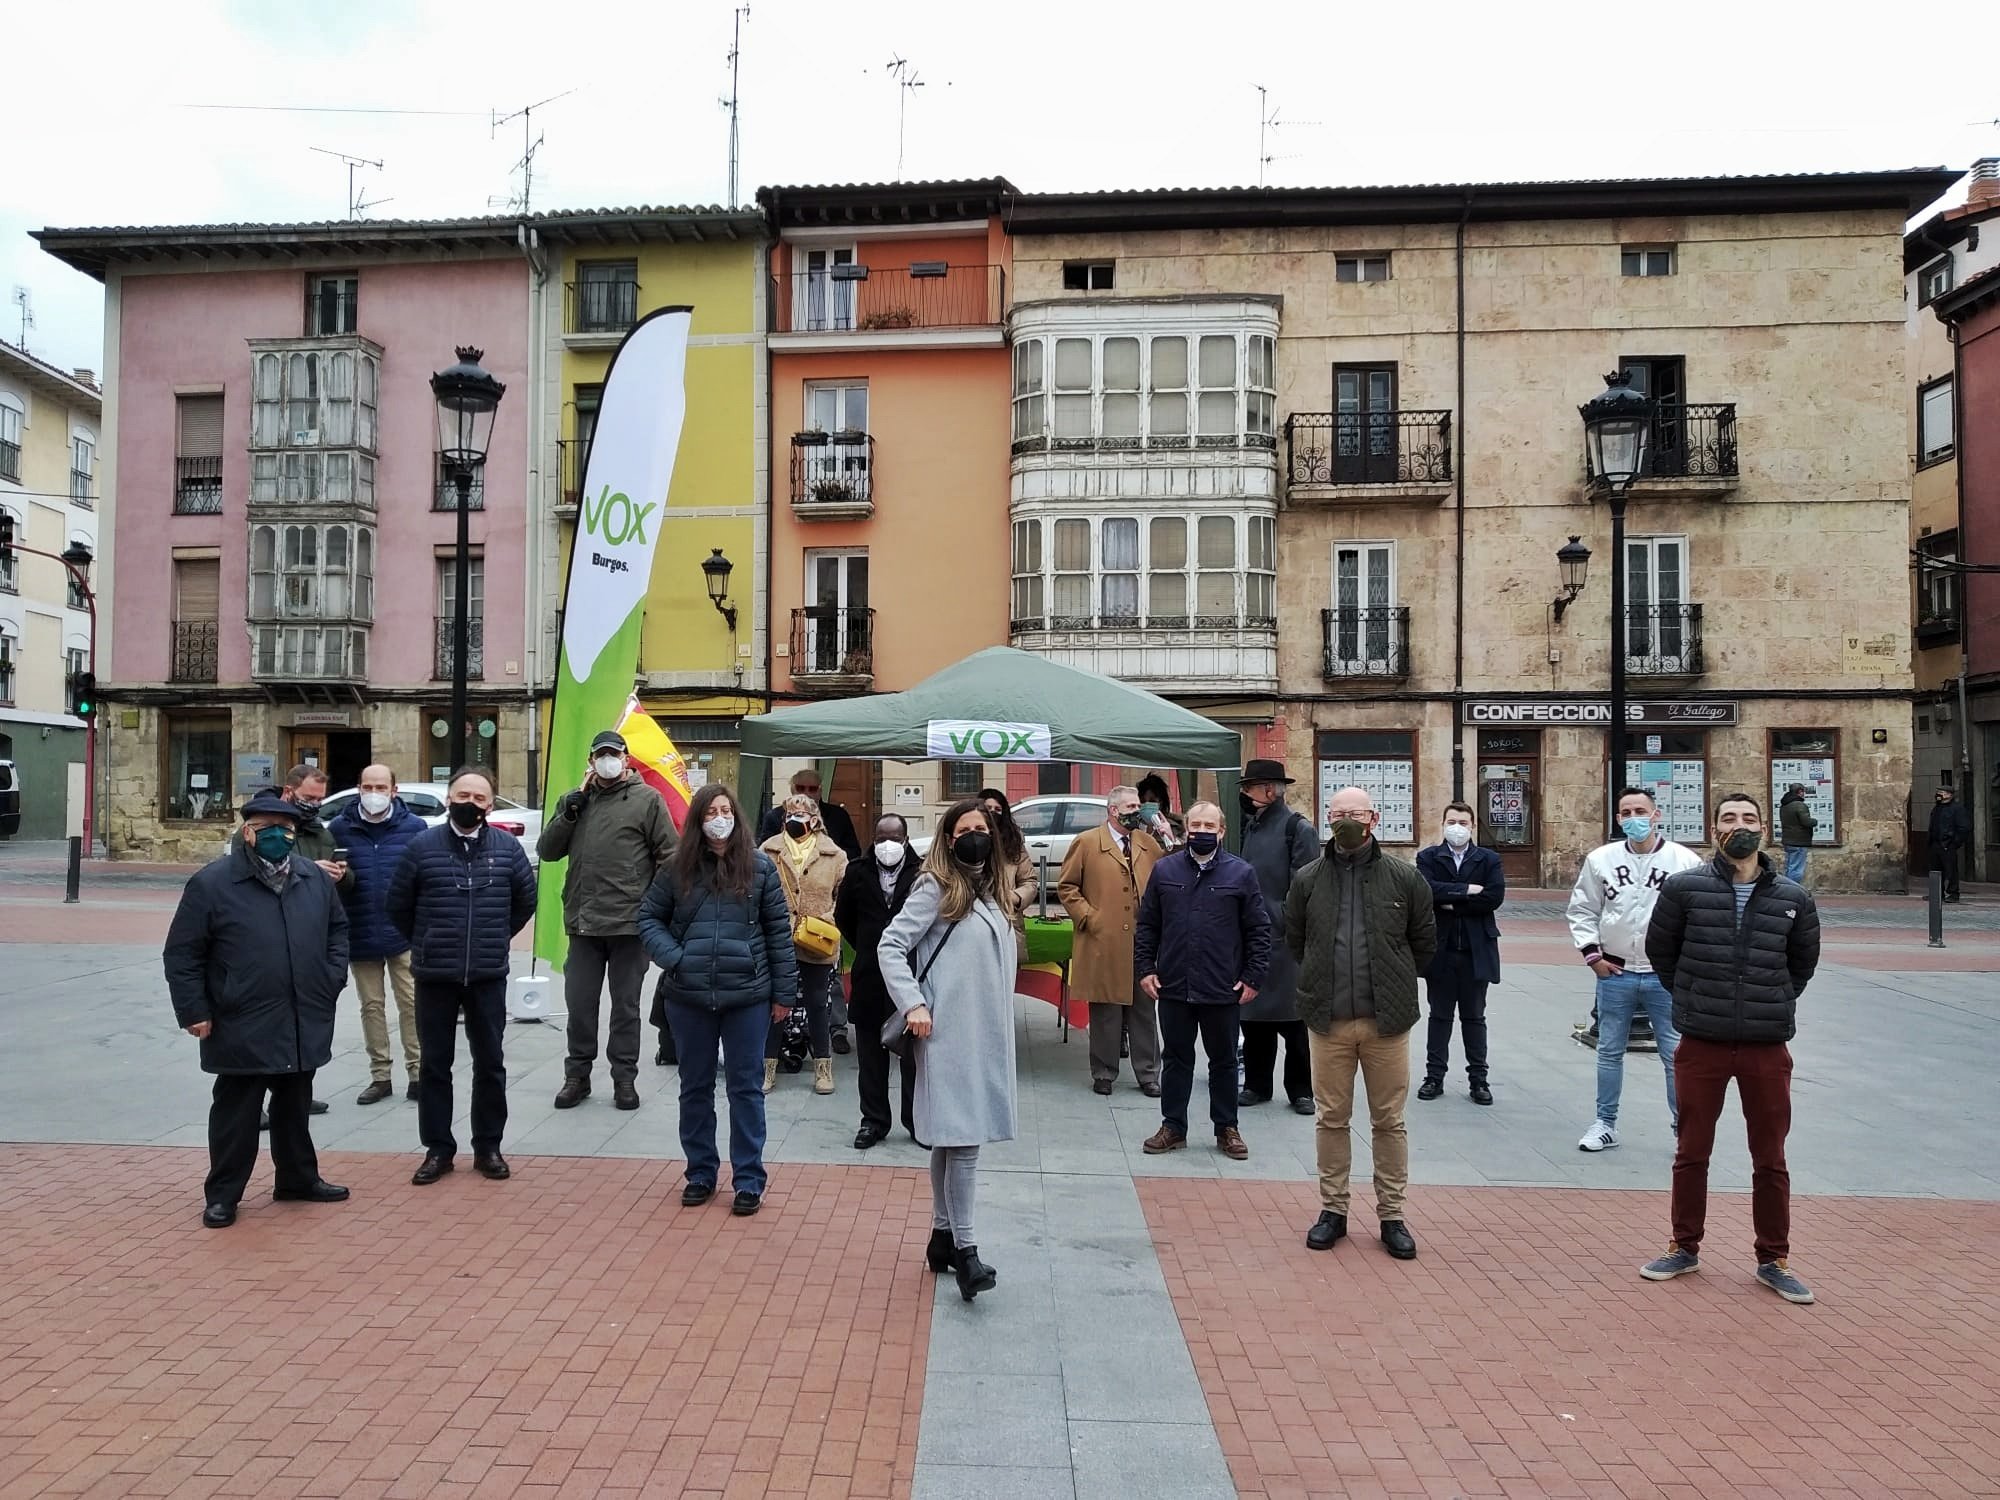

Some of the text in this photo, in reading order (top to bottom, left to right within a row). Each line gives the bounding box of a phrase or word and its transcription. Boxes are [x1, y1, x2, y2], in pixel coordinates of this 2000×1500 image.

[585, 484, 657, 546] VOX
[592, 552, 629, 573] Burgos.
[1682, 703, 1727, 719] Gallego
[949, 729, 1035, 758] VOX
[1492, 813, 1521, 822] VEDE
